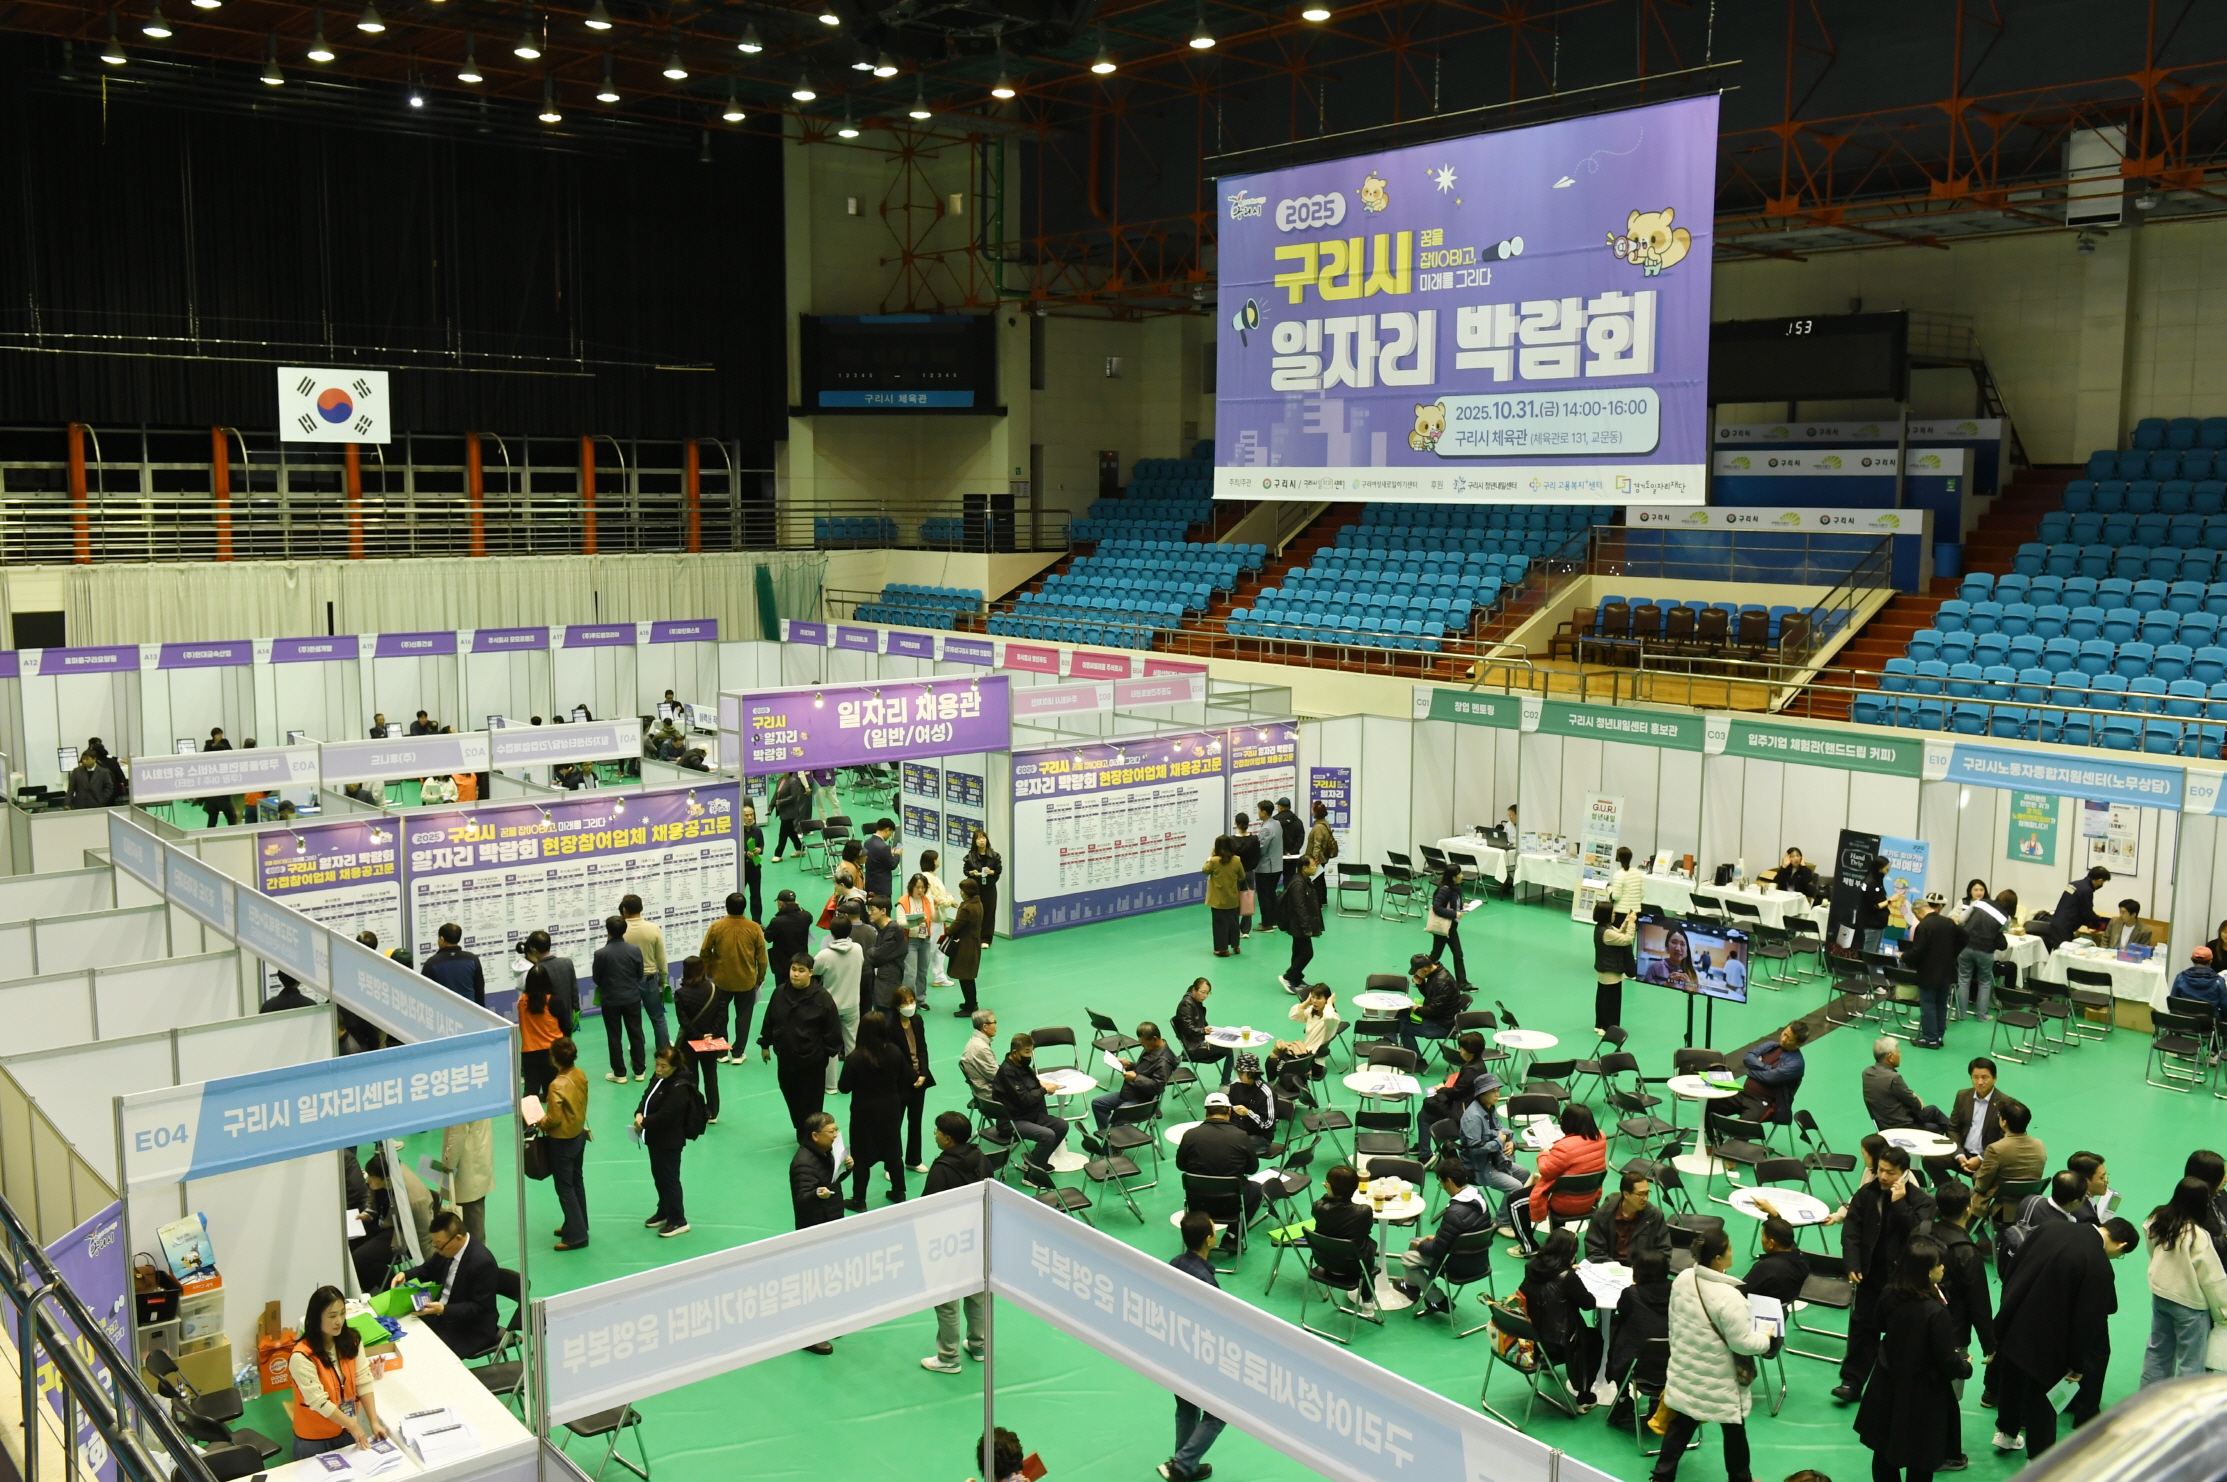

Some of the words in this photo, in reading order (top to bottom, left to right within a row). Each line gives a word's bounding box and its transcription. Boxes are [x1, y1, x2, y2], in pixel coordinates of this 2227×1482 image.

[1286, 199, 1335, 225] 2025
[1420, 228, 1444, 247] 꿈을
[1275, 230, 1413, 305] 구리시
[1420, 272, 1453, 291] 미래를
[1455, 268, 1492, 289] 그리다
[1271, 309, 1437, 391] 일자리
[1455, 290, 1657, 382] 박람회
[865, 394, 894, 403] 구리시
[898, 394, 927, 404] 체육관
[1562, 399, 1648, 417] 14:00-16:00
[1455, 430, 1490, 447] 구리시
[1492, 429, 1528, 446] 체육관
[1530, 432, 1570, 446] (체육관로
[1572, 432, 1589, 446] 131,
[1591, 431, 1623, 445] 교문동)
[1875, 458, 1896, 466] 구리시
[1274, 479, 1296, 489] 구리시
[1430, 480, 1443, 489] 후원
[1543, 481, 1556, 490] 구리
[1651, 513, 1670, 521] 구리시
[1739, 515, 1758, 523] 구리시
[460, 638, 472, 646] A16
[488, 636, 509, 645] 주식회사
[553, 633, 563, 641] A17
[144, 653, 158, 661] A13
[257, 648, 270, 656] A14
[23, 659, 38, 667] A12
[1416, 698, 1429, 707] C01
[1454, 701, 1470, 713] 창업
[1471, 703, 1494, 716] 멘토링
[838, 697, 907, 729] 일자리
[915, 691, 982, 721] 채용관
[1523, 710, 1539, 719] C02
[752, 715, 786, 730] 구리시
[1569, 714, 1594, 728] 구리시
[1596, 718, 1648, 734] 청년내일센터
[1651, 723, 1678, 737] 홍보관
[764, 730, 798, 745] 일자리
[863, 721, 953, 749] (일반/여성)
[1707, 730, 1726, 740] C03
[1243, 749, 1258, 757] 구리시
[1258, 745, 1276, 756] 일자리
[1748, 733, 1787, 749] 입주기업
[1790, 738, 1867, 759] 체험관(핸드드립
[1870, 746, 1896, 762] 커피)
[753, 747, 787, 762] 박람회
[1929, 755, 1947, 765] E10
[1039, 760, 1070, 774] 구리시
[1125, 756, 1141, 765] 그리다
[1015, 776, 1055, 797] 일자리
[1058, 772, 1097, 791] 박람회
[1100, 764, 1167, 787] 현장참여업체
[1170, 756, 1222, 775] 채용공고문
[1313, 780, 1337, 788] 구리시
[1320, 790, 1344, 798] 일자리
[2190, 786, 2213, 798] E09
[416, 832, 441, 843] 2025
[448, 824, 495, 843] 구리시
[500, 826, 516, 838] 꿈을
[558, 820, 581, 832] 미래를
[583, 817, 606, 829] 그리다
[411, 845, 474, 872] 일자리
[479, 838, 538, 863] 박람회
[542, 826, 646, 857] 현장참여업체
[651, 816, 731, 843] 채용공고문
[1850, 852, 1866, 862] Hand
[1883, 849, 1900, 859] 경기도
[287, 861, 317, 873] 구리시
[319, 854, 357, 870] 일자리
[358, 849, 395, 863] 박람회
[1850, 859, 1864, 869] Drip
[266, 870, 337, 890] 간접참여업체
[339, 863, 395, 880] 채용공고문
[1842, 877, 1855, 887] 체험
[223, 1103, 290, 1138] 구리시
[297, 1078, 403, 1124] 일자리센터
[410, 1061, 490, 1101] 운영본부
[134, 1123, 188, 1152] E04
[270, 1373, 288, 1381] GOOD
